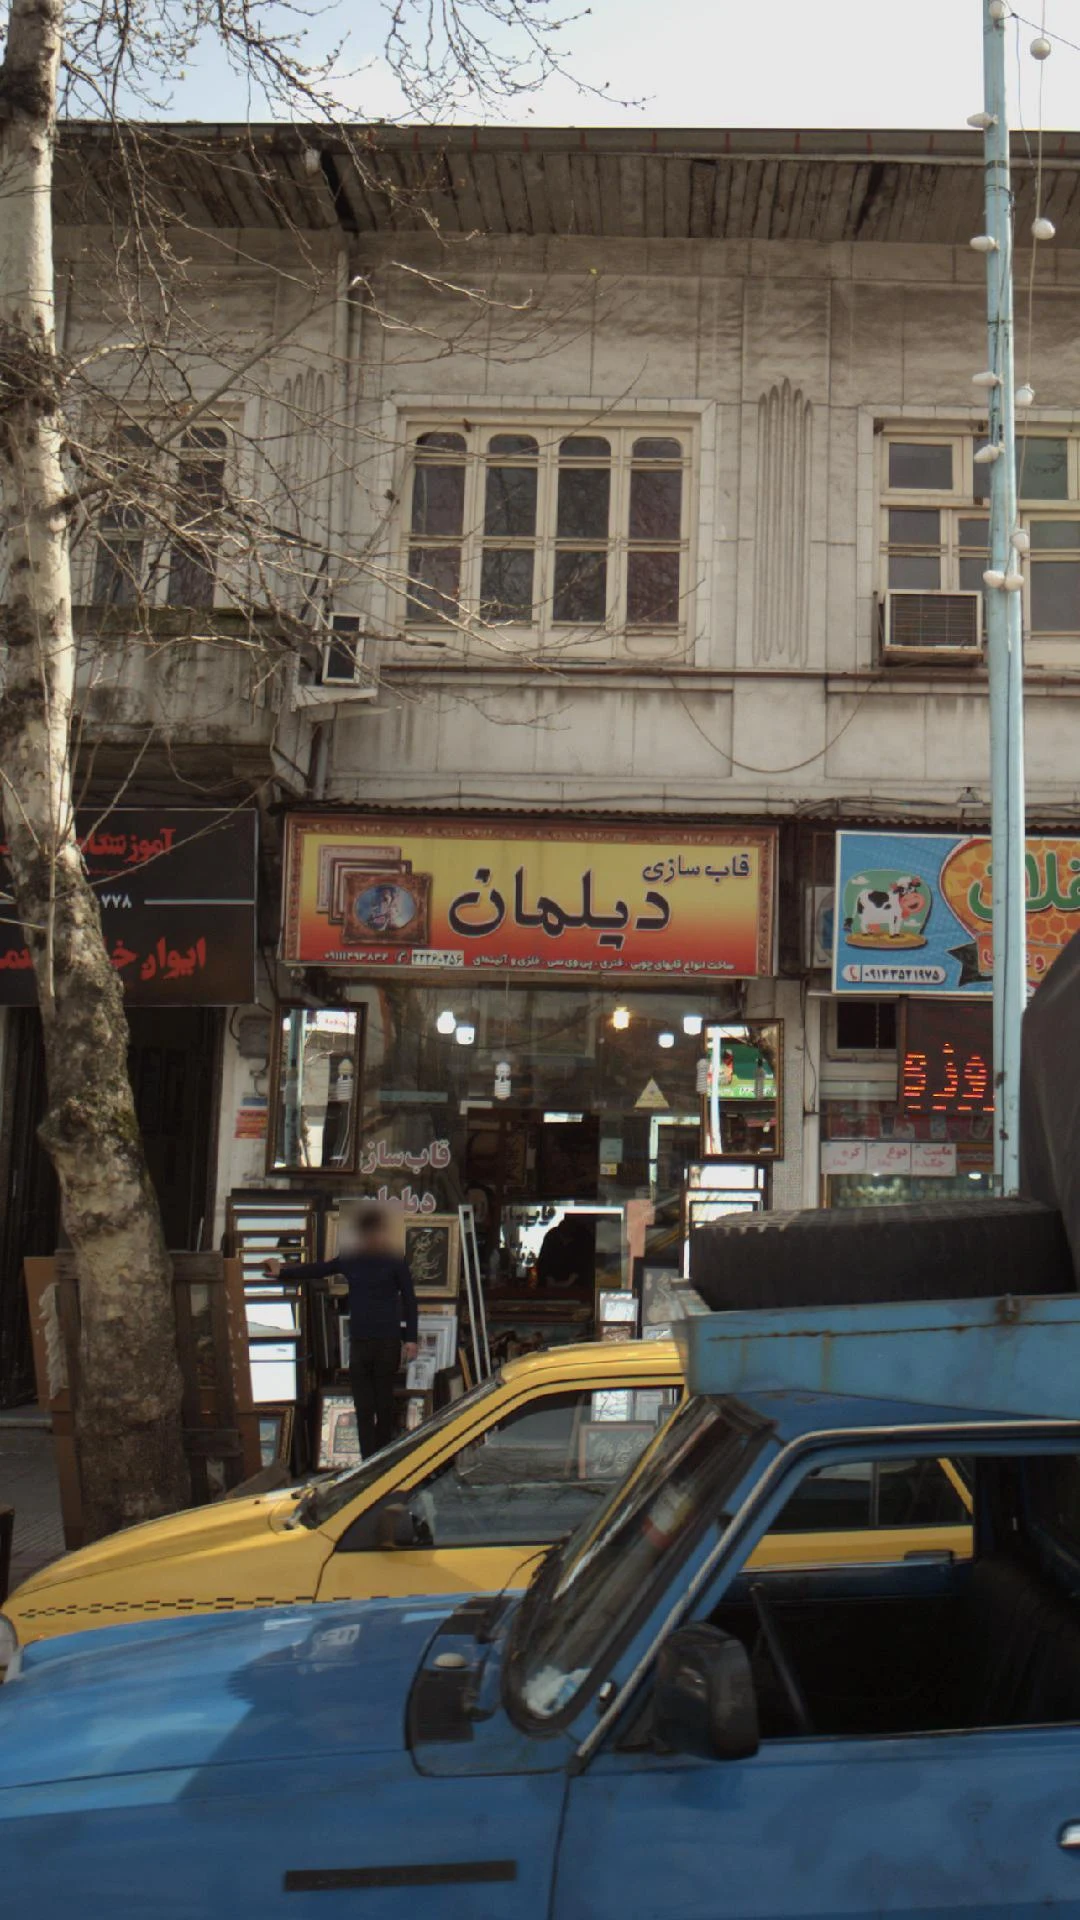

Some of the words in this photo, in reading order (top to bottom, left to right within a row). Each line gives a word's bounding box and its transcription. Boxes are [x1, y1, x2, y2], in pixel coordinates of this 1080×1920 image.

[642, 854, 700, 882] سازی
[704, 854, 750, 882] قاب
[448, 865, 671, 950] دیلمان
[359, 1139, 404, 1174] ساز
[404, 1139, 451, 1174] قاب
